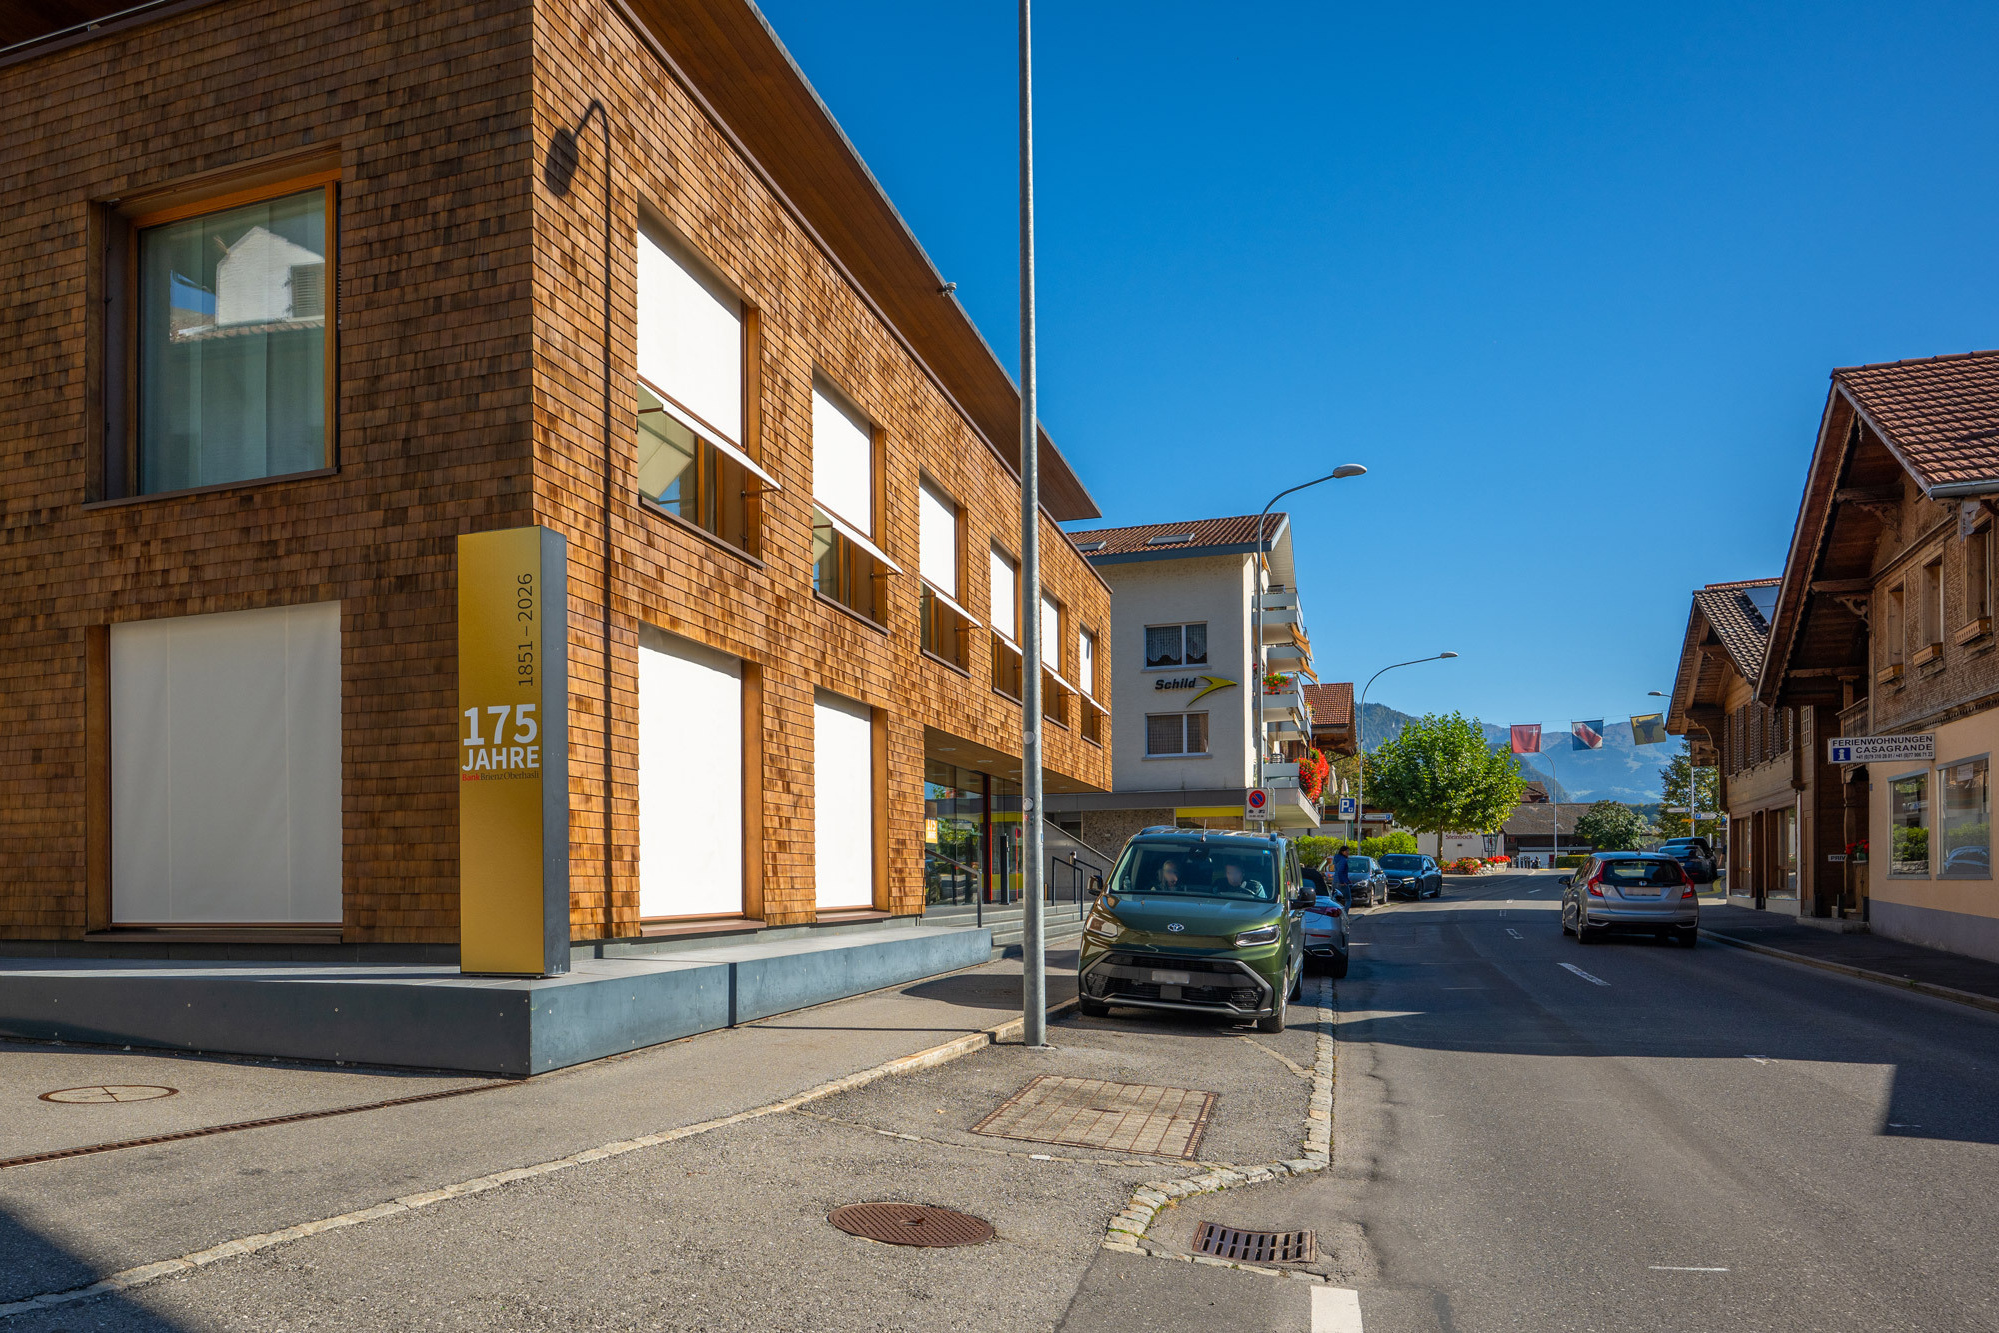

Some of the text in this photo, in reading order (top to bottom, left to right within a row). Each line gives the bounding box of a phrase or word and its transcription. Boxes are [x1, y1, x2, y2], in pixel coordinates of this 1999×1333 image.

[517, 573, 533, 622] 2026
[518, 640, 533, 686] 1851
[1155, 677, 1197, 690] Schild
[463, 703, 538, 746] 175
[1832, 735, 1933, 747] FERIENWOHNUNGEN
[1855, 743, 1933, 754] CASAGRANDE
[462, 745, 540, 771] JAHRE
[1341, 799, 1349, 812] P
